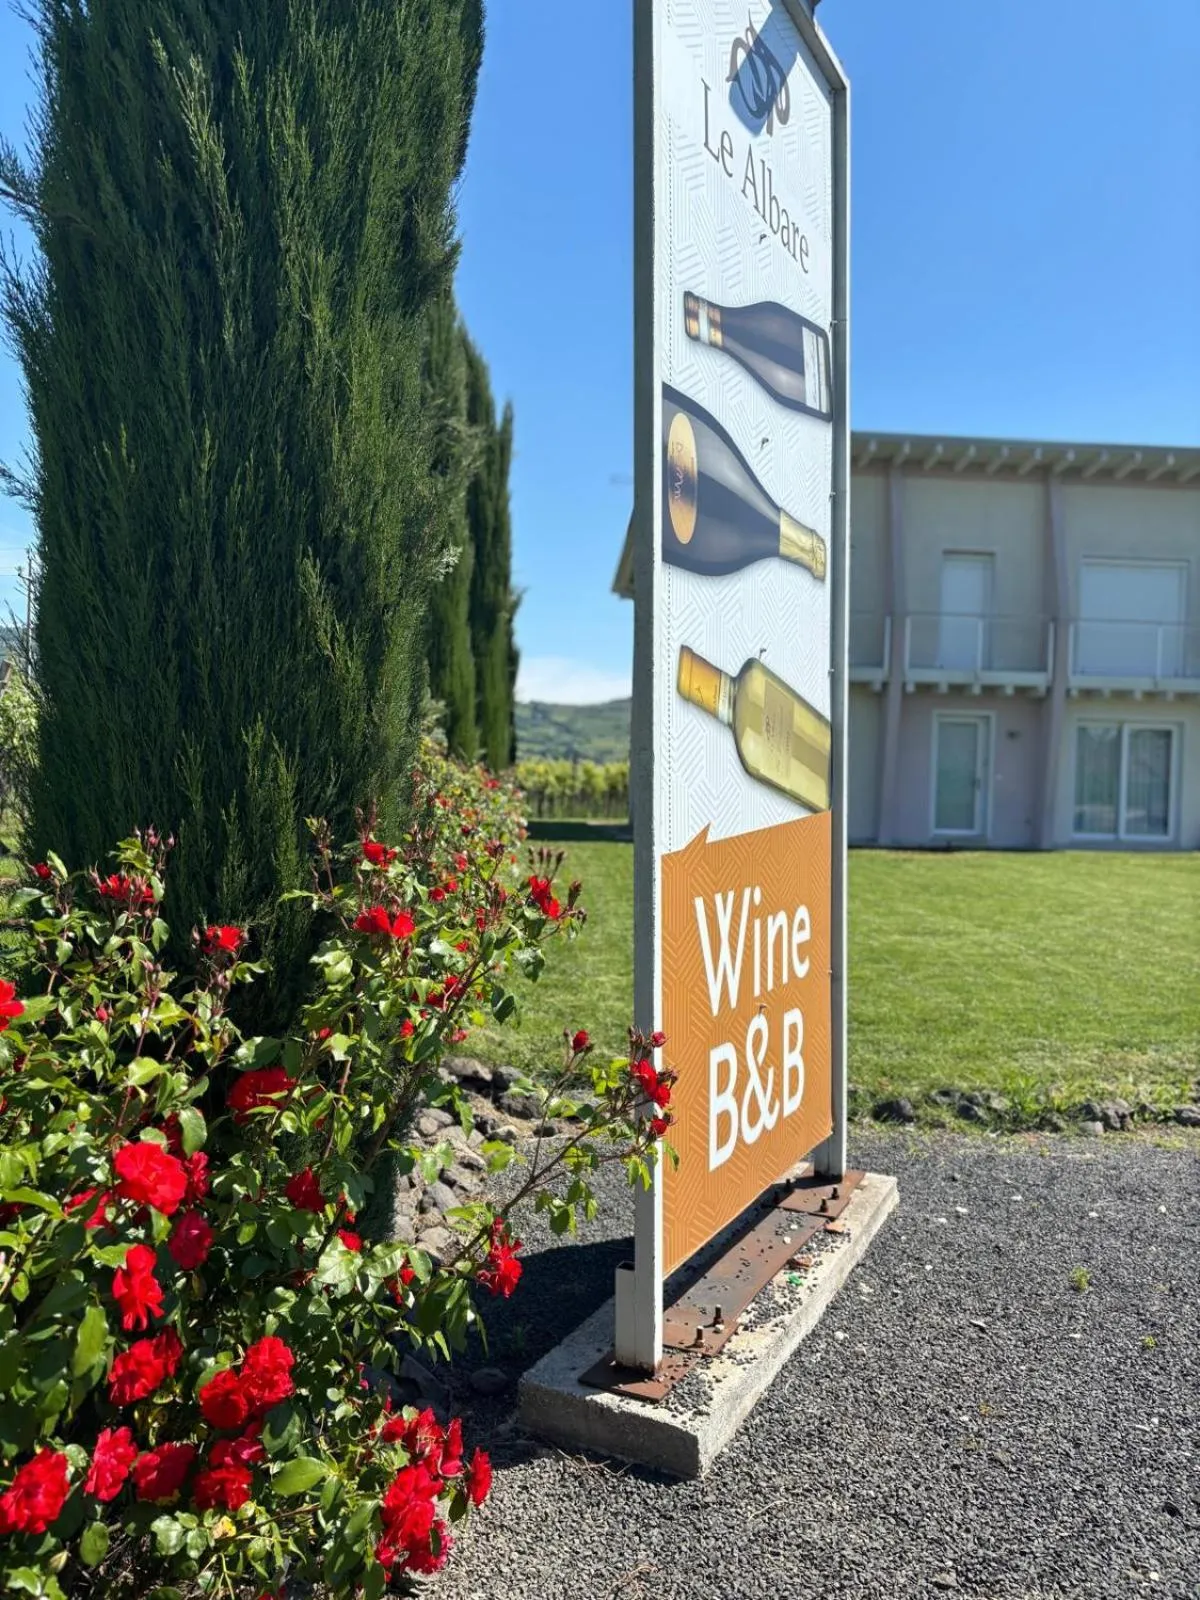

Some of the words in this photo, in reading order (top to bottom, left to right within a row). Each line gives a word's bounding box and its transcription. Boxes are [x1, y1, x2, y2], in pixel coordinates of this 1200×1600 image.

[701, 78, 733, 178] Le
[741, 144, 809, 274] Albare
[694, 885, 811, 1017] Wine
[708, 1008, 805, 1172] B&B
